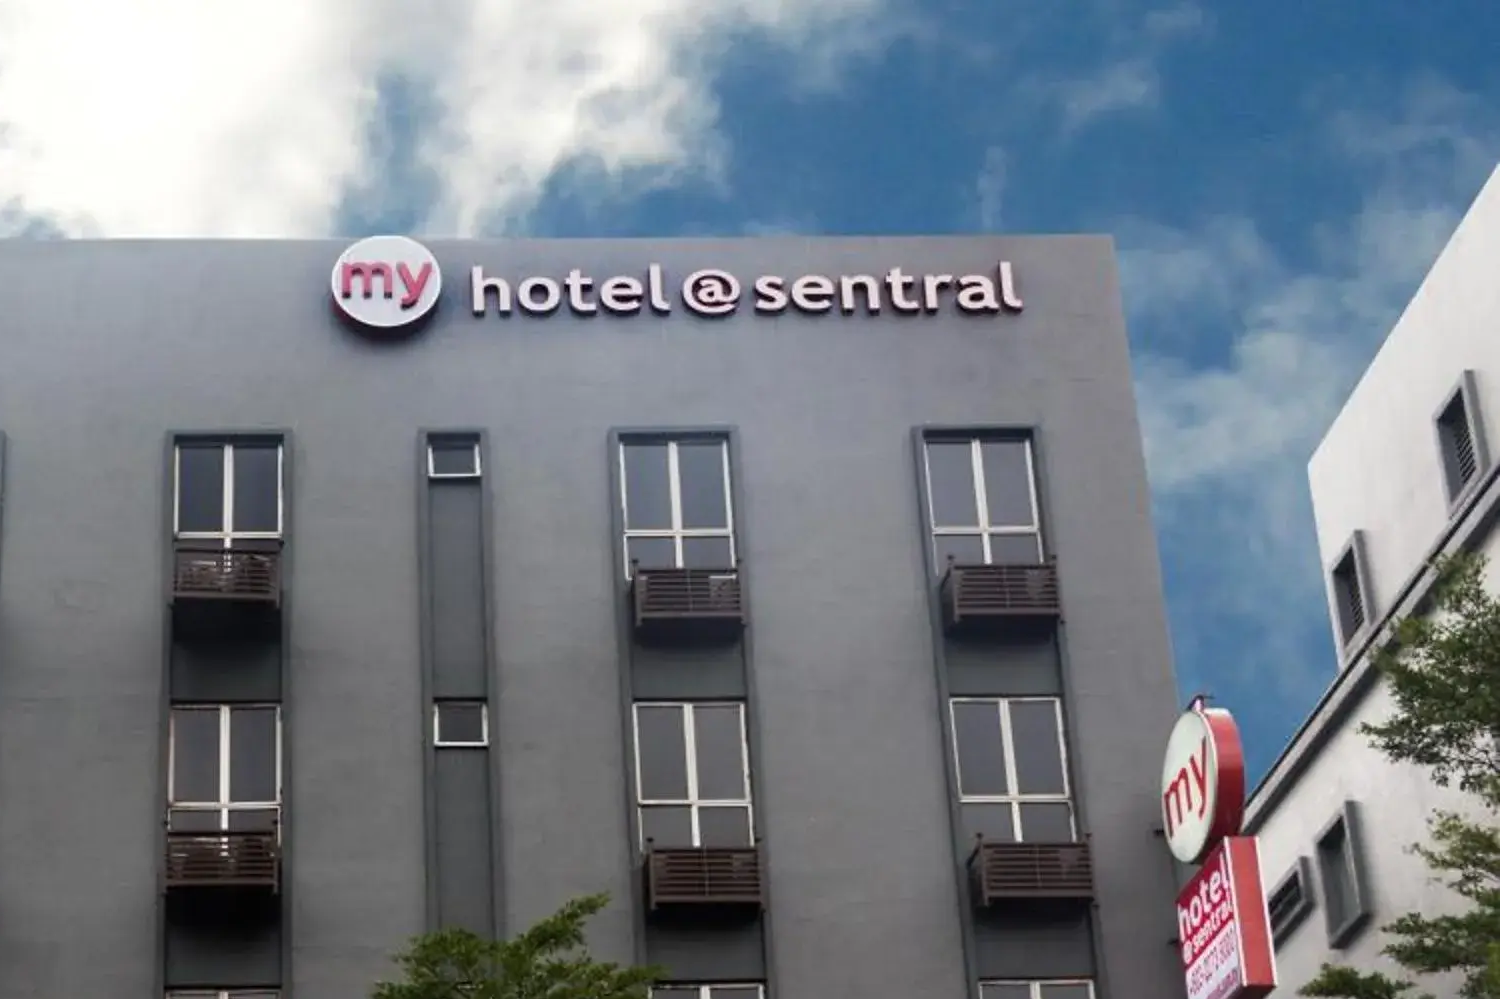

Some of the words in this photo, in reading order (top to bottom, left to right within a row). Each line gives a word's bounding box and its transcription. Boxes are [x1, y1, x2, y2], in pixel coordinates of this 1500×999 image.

[341, 261, 433, 308] my
[1163, 736, 1208, 840] my
[1177, 852, 1231, 932] hotel
